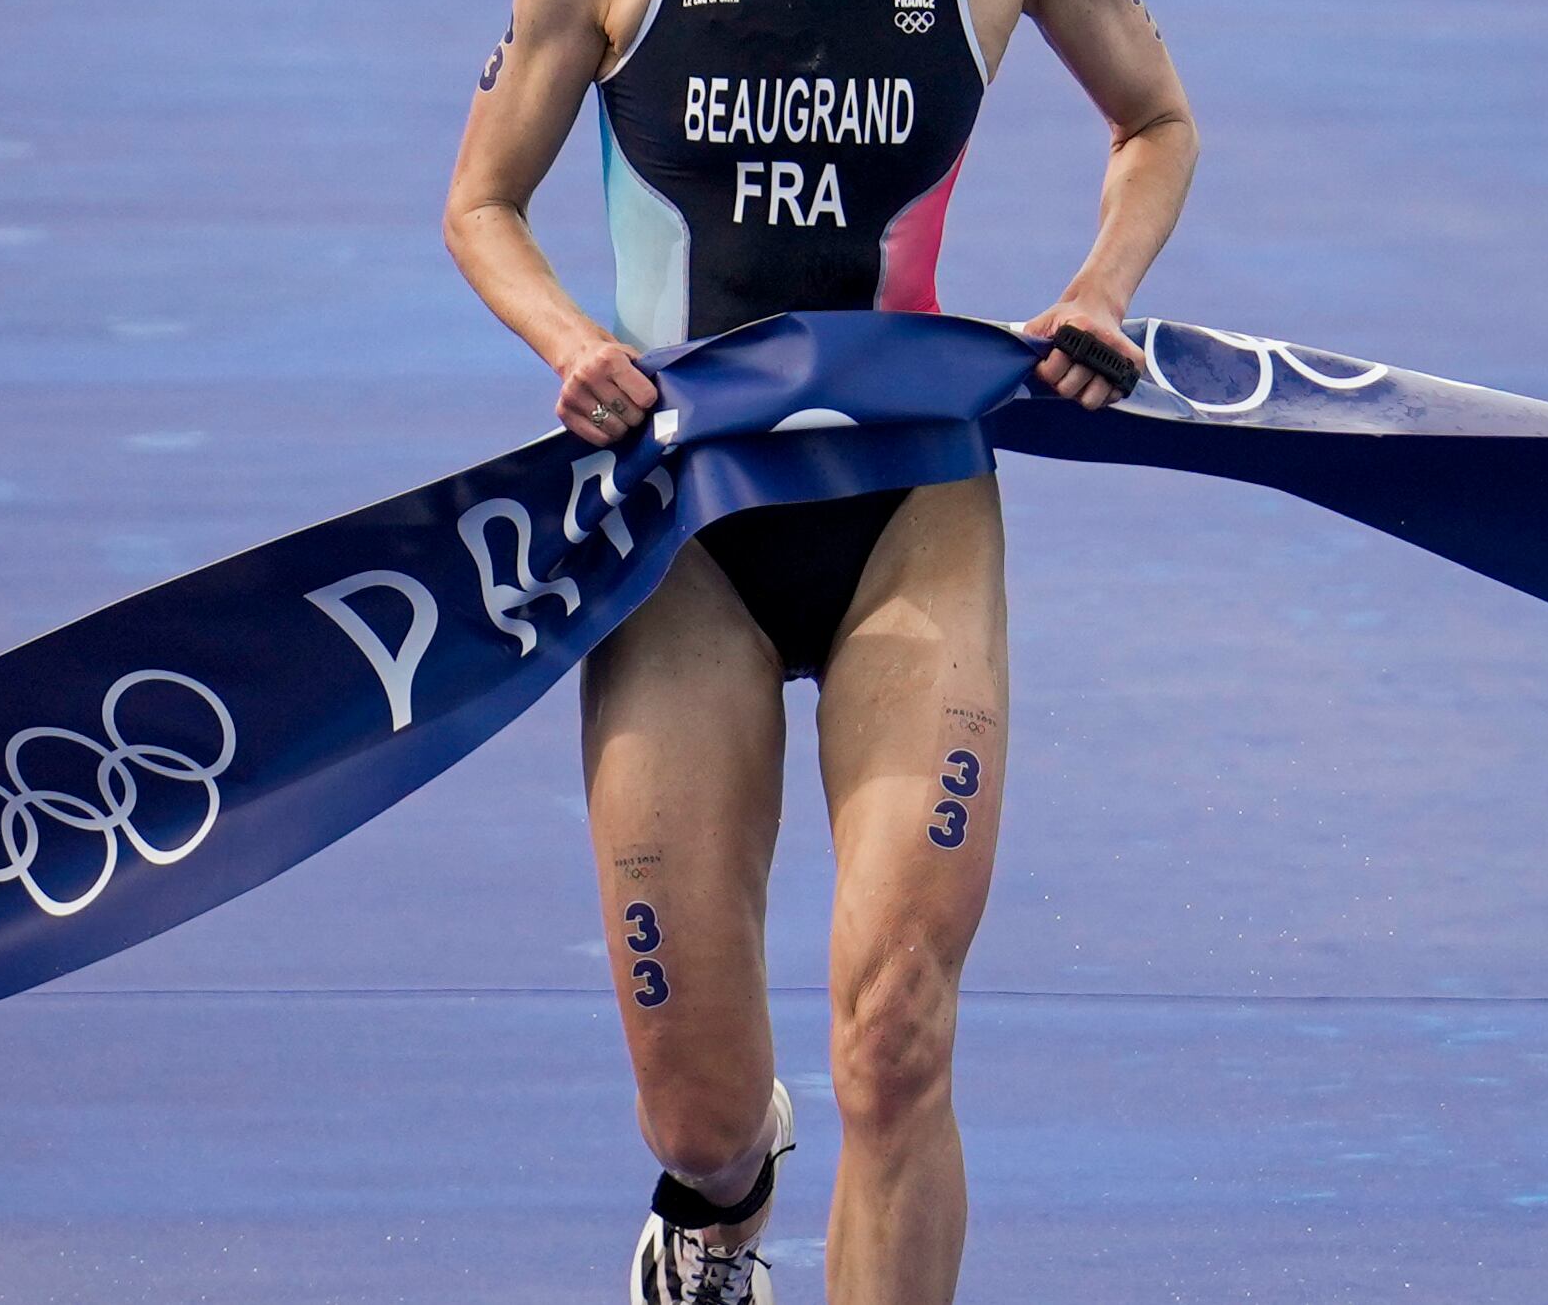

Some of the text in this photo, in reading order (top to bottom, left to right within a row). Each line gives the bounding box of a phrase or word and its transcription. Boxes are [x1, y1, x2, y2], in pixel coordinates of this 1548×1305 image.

[684, 76, 915, 145] BEAUGRAND
[733, 161, 847, 228] FRA
[303, 400, 680, 732] PAR
